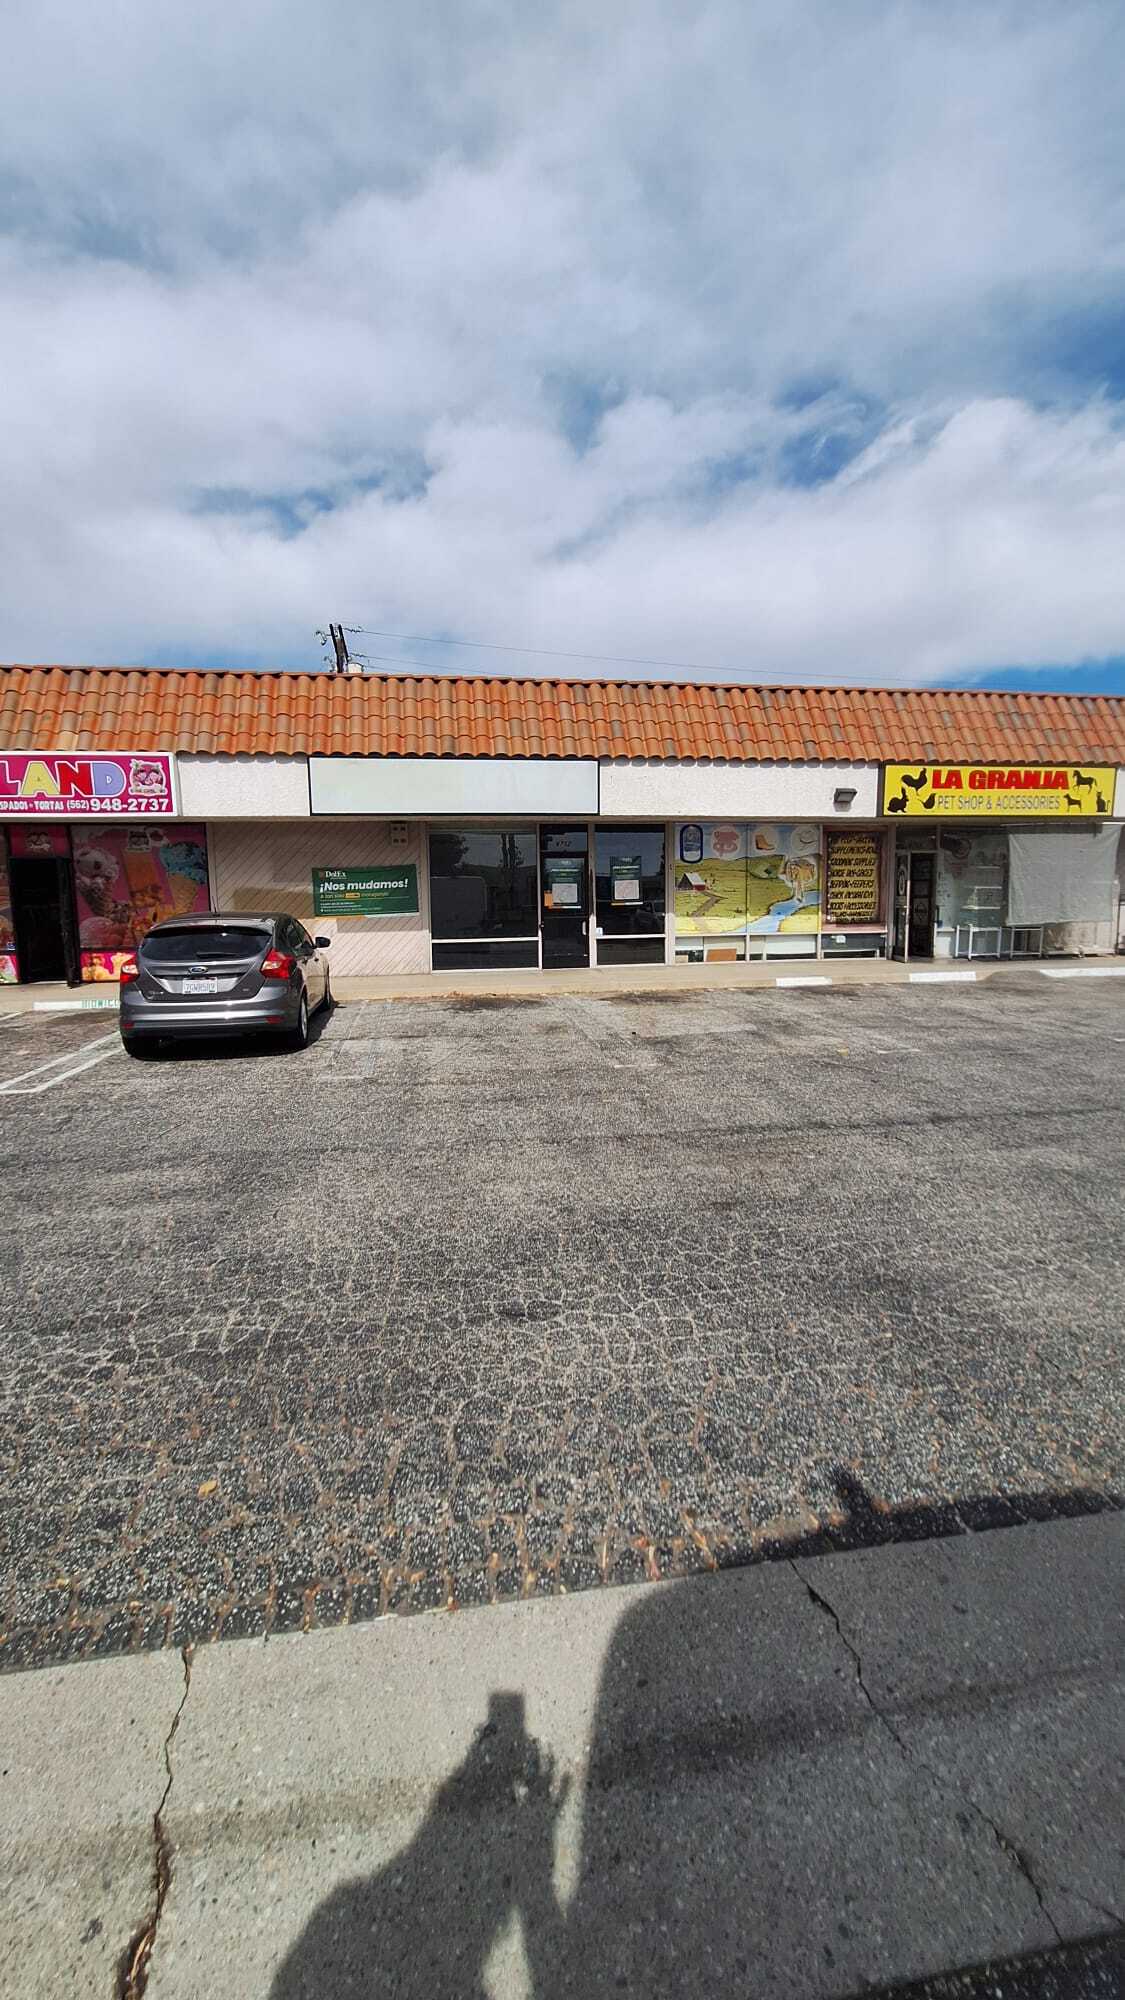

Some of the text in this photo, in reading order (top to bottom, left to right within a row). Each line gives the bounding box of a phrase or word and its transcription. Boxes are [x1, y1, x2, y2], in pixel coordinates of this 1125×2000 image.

[0, 760, 126, 798] LAND
[931, 769, 1070, 790] LA GRANJA
[34, 800, 64, 810] TORTAS
[90, 798, 168, 812] 948-2737
[938, 795, 954, 810] PET
[957, 795, 984, 810] SHOP
[996, 794, 1060, 810] ACCESSORIES
[320, 878, 408, 892] ¡Nos mudamos!
